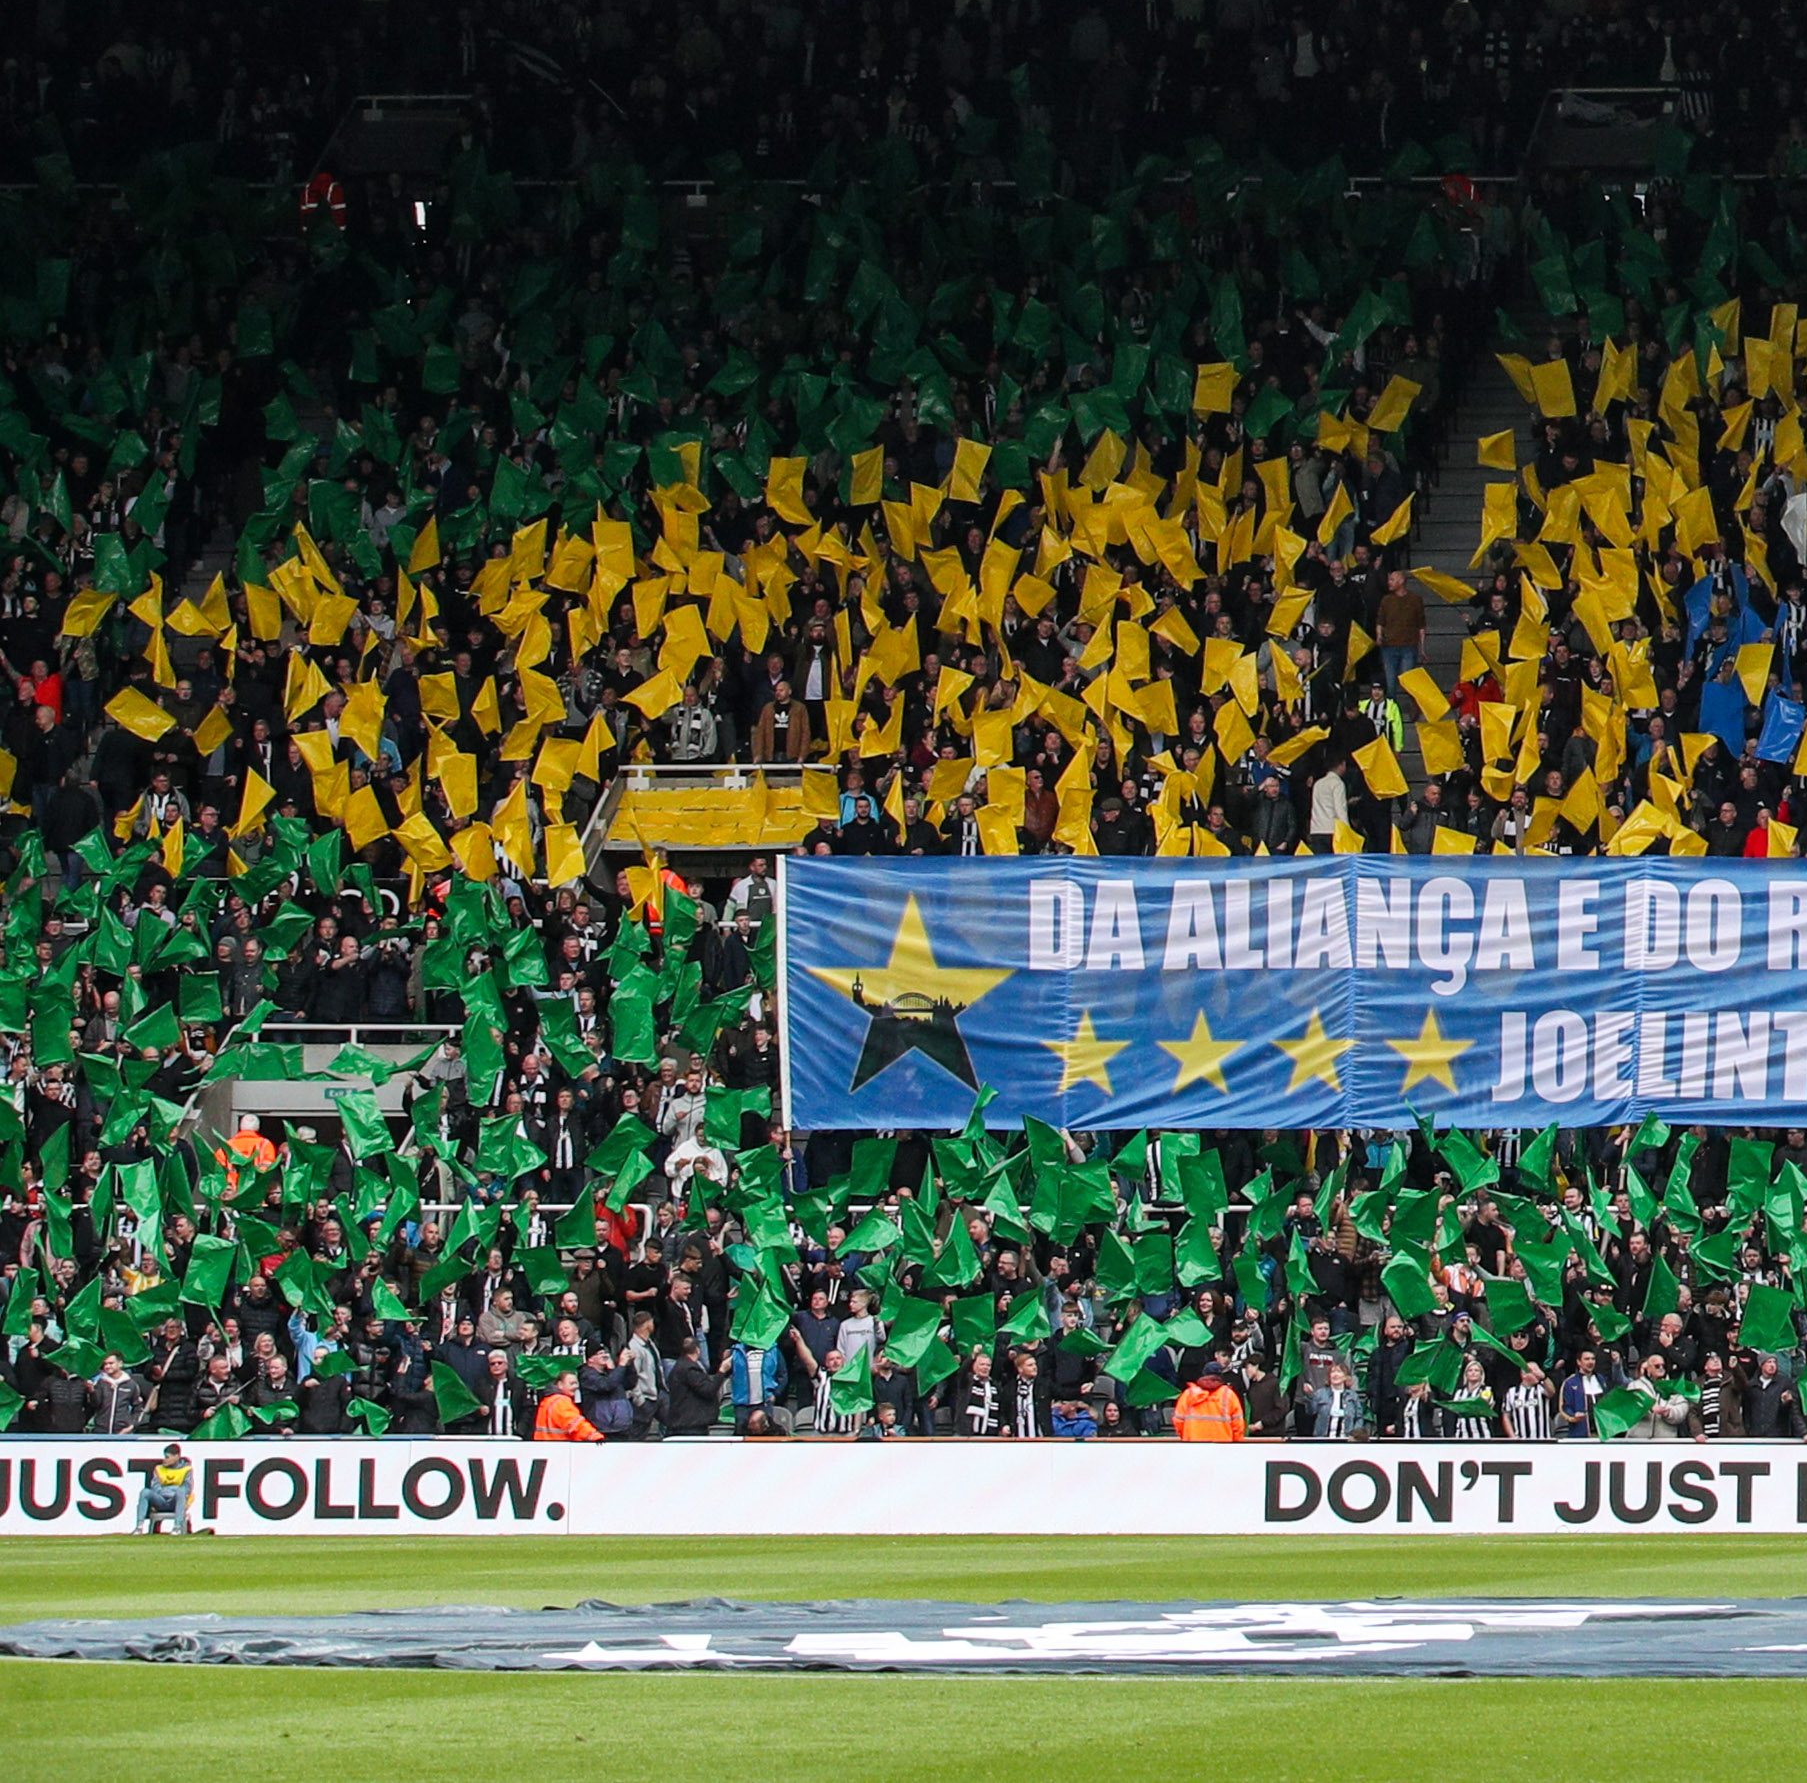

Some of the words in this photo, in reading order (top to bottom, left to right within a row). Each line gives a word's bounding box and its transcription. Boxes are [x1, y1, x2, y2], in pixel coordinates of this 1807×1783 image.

[1027, 878, 1154, 972] DA
[1161, 877, 1534, 997] ALIANÇA
[1556, 879, 1601, 972] E
[1624, 879, 1743, 973] DO
[203, 1458, 563, 1521] FOLLOW.
[1264, 1461, 1532, 1524] DON'T
[1554, 1462, 1771, 1524] JUST
